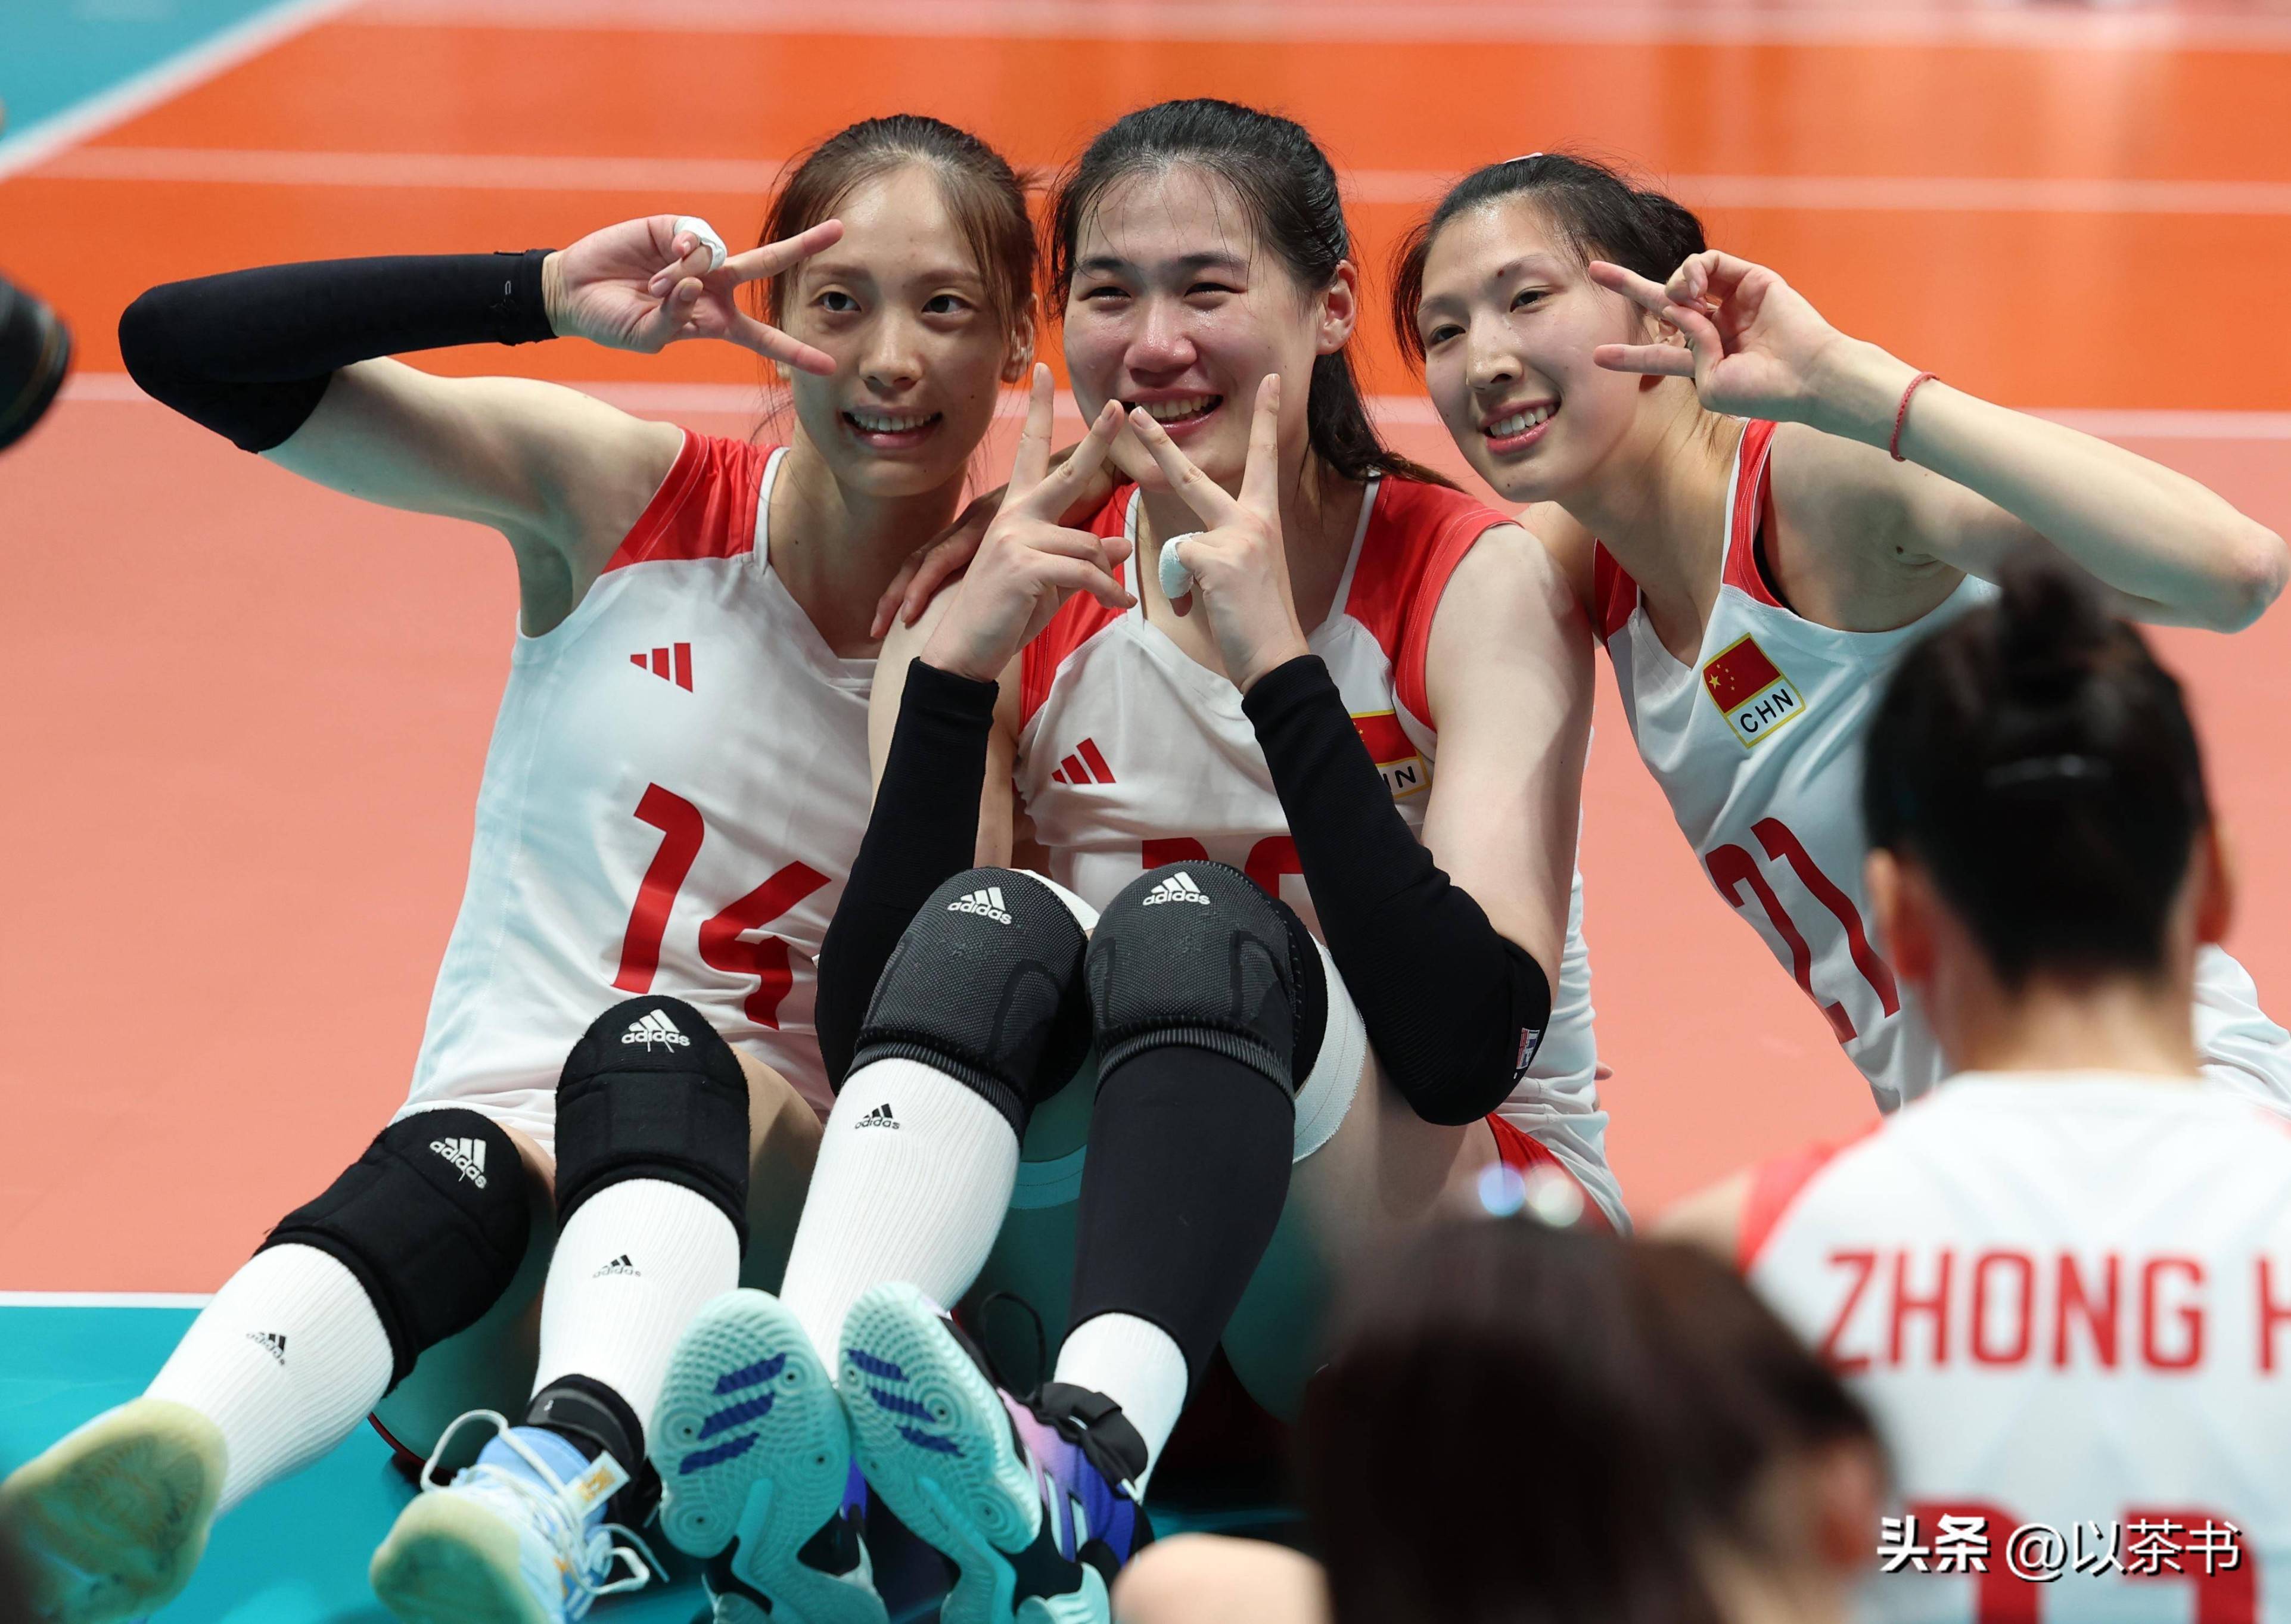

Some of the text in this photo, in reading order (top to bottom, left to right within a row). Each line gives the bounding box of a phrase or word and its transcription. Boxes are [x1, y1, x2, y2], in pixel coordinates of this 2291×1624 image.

[1740, 688, 1793, 733] CHN
[611, 782, 832, 1031] 14
[947, 900, 1012, 925] adidas
[1142, 889, 1211, 906] adidas
[621, 1029, 690, 1046] adidas
[854, 1116, 900, 1130] adidas
[430, 1141, 487, 1189] adidas
[1818, 1247, 2208, 1373] ZHONG
